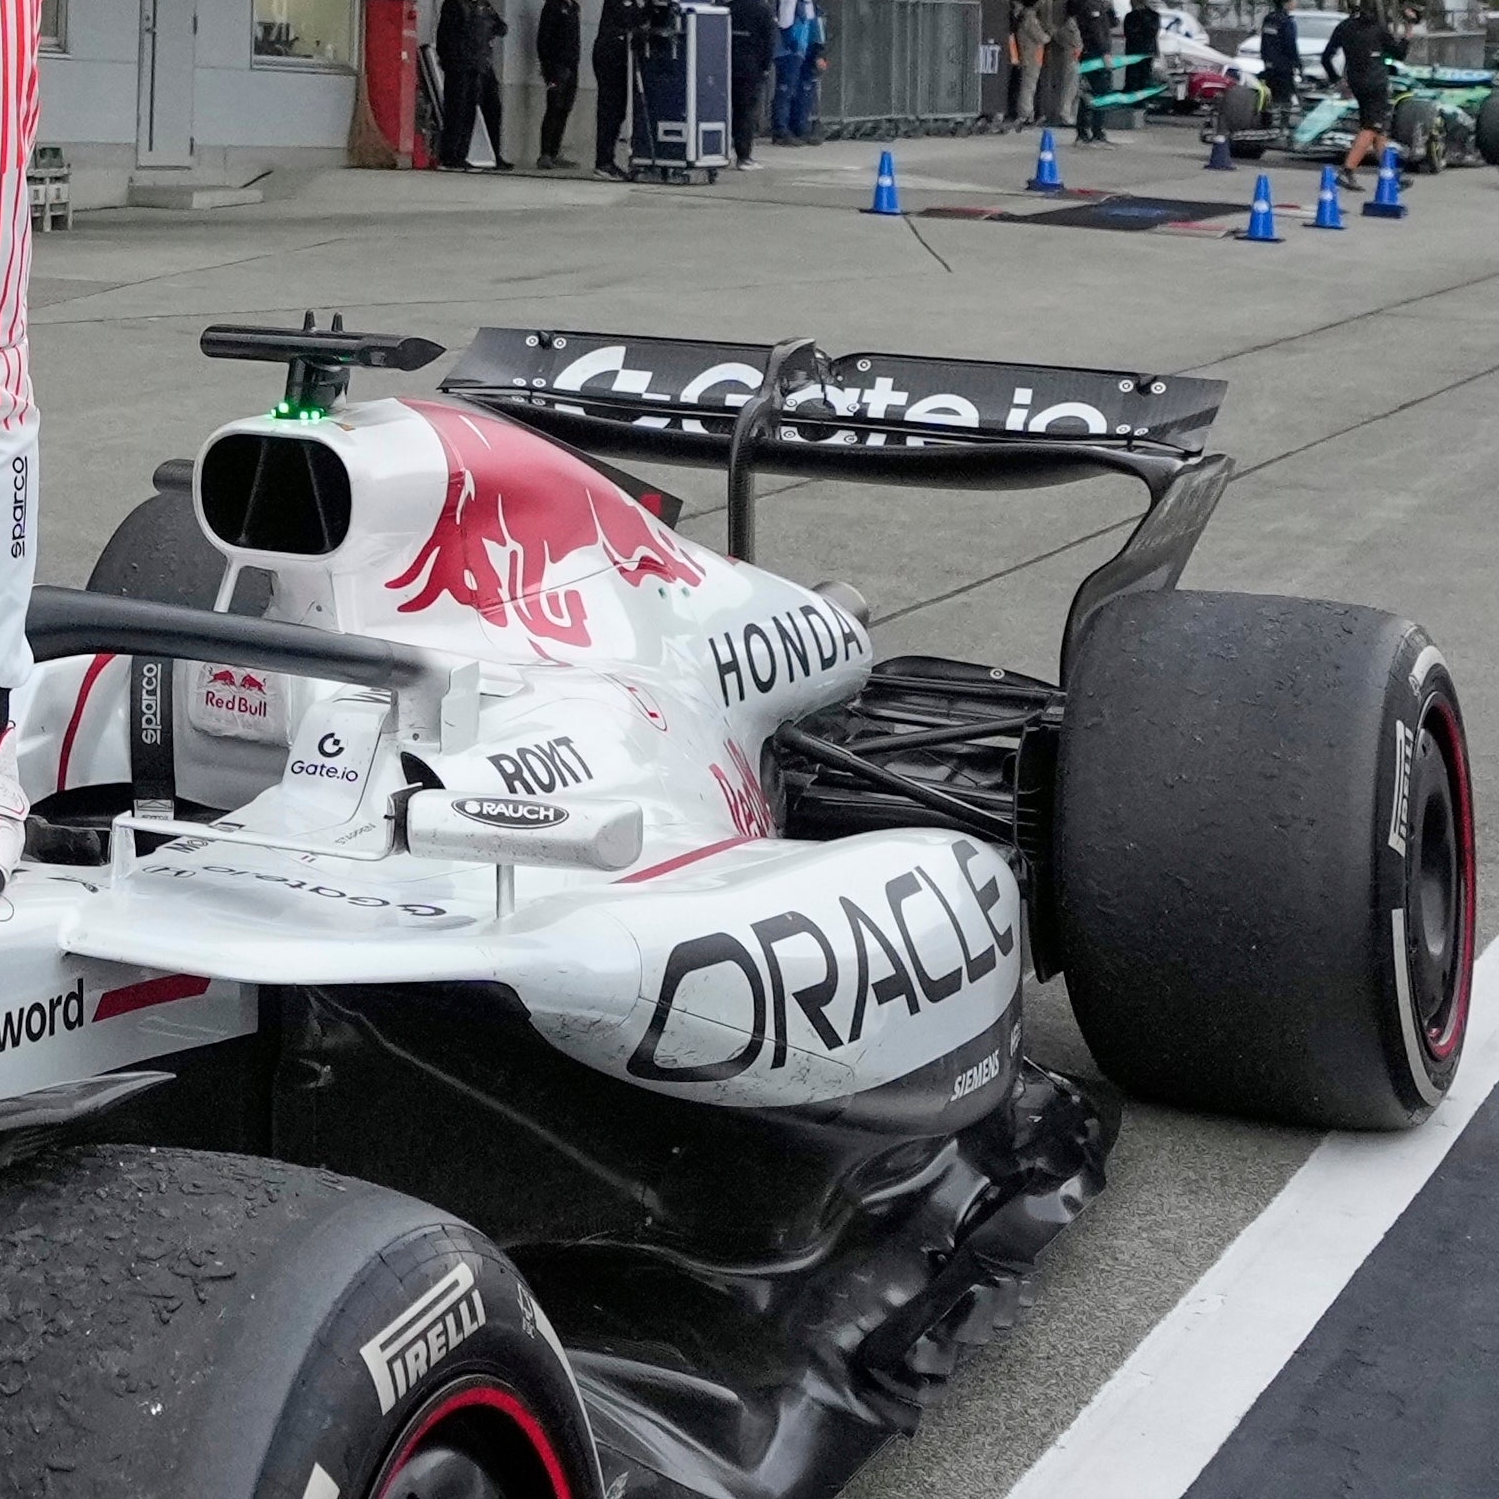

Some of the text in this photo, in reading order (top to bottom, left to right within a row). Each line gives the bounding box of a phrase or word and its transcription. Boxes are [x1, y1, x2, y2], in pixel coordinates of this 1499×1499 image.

[10, 456, 29, 559] sparco
[709, 598, 865, 708] HONDA
[141, 662, 163, 745] sparco
[205, 690, 268, 718] Red Bull
[290, 760, 360, 783] Gate.io
[481, 801, 558, 823] RAUCH
[627, 838, 1017, 1084] ORACLE
[950, 1048, 1000, 1102] SIEMENS
[359, 1261, 486, 1416] PIRELLI
